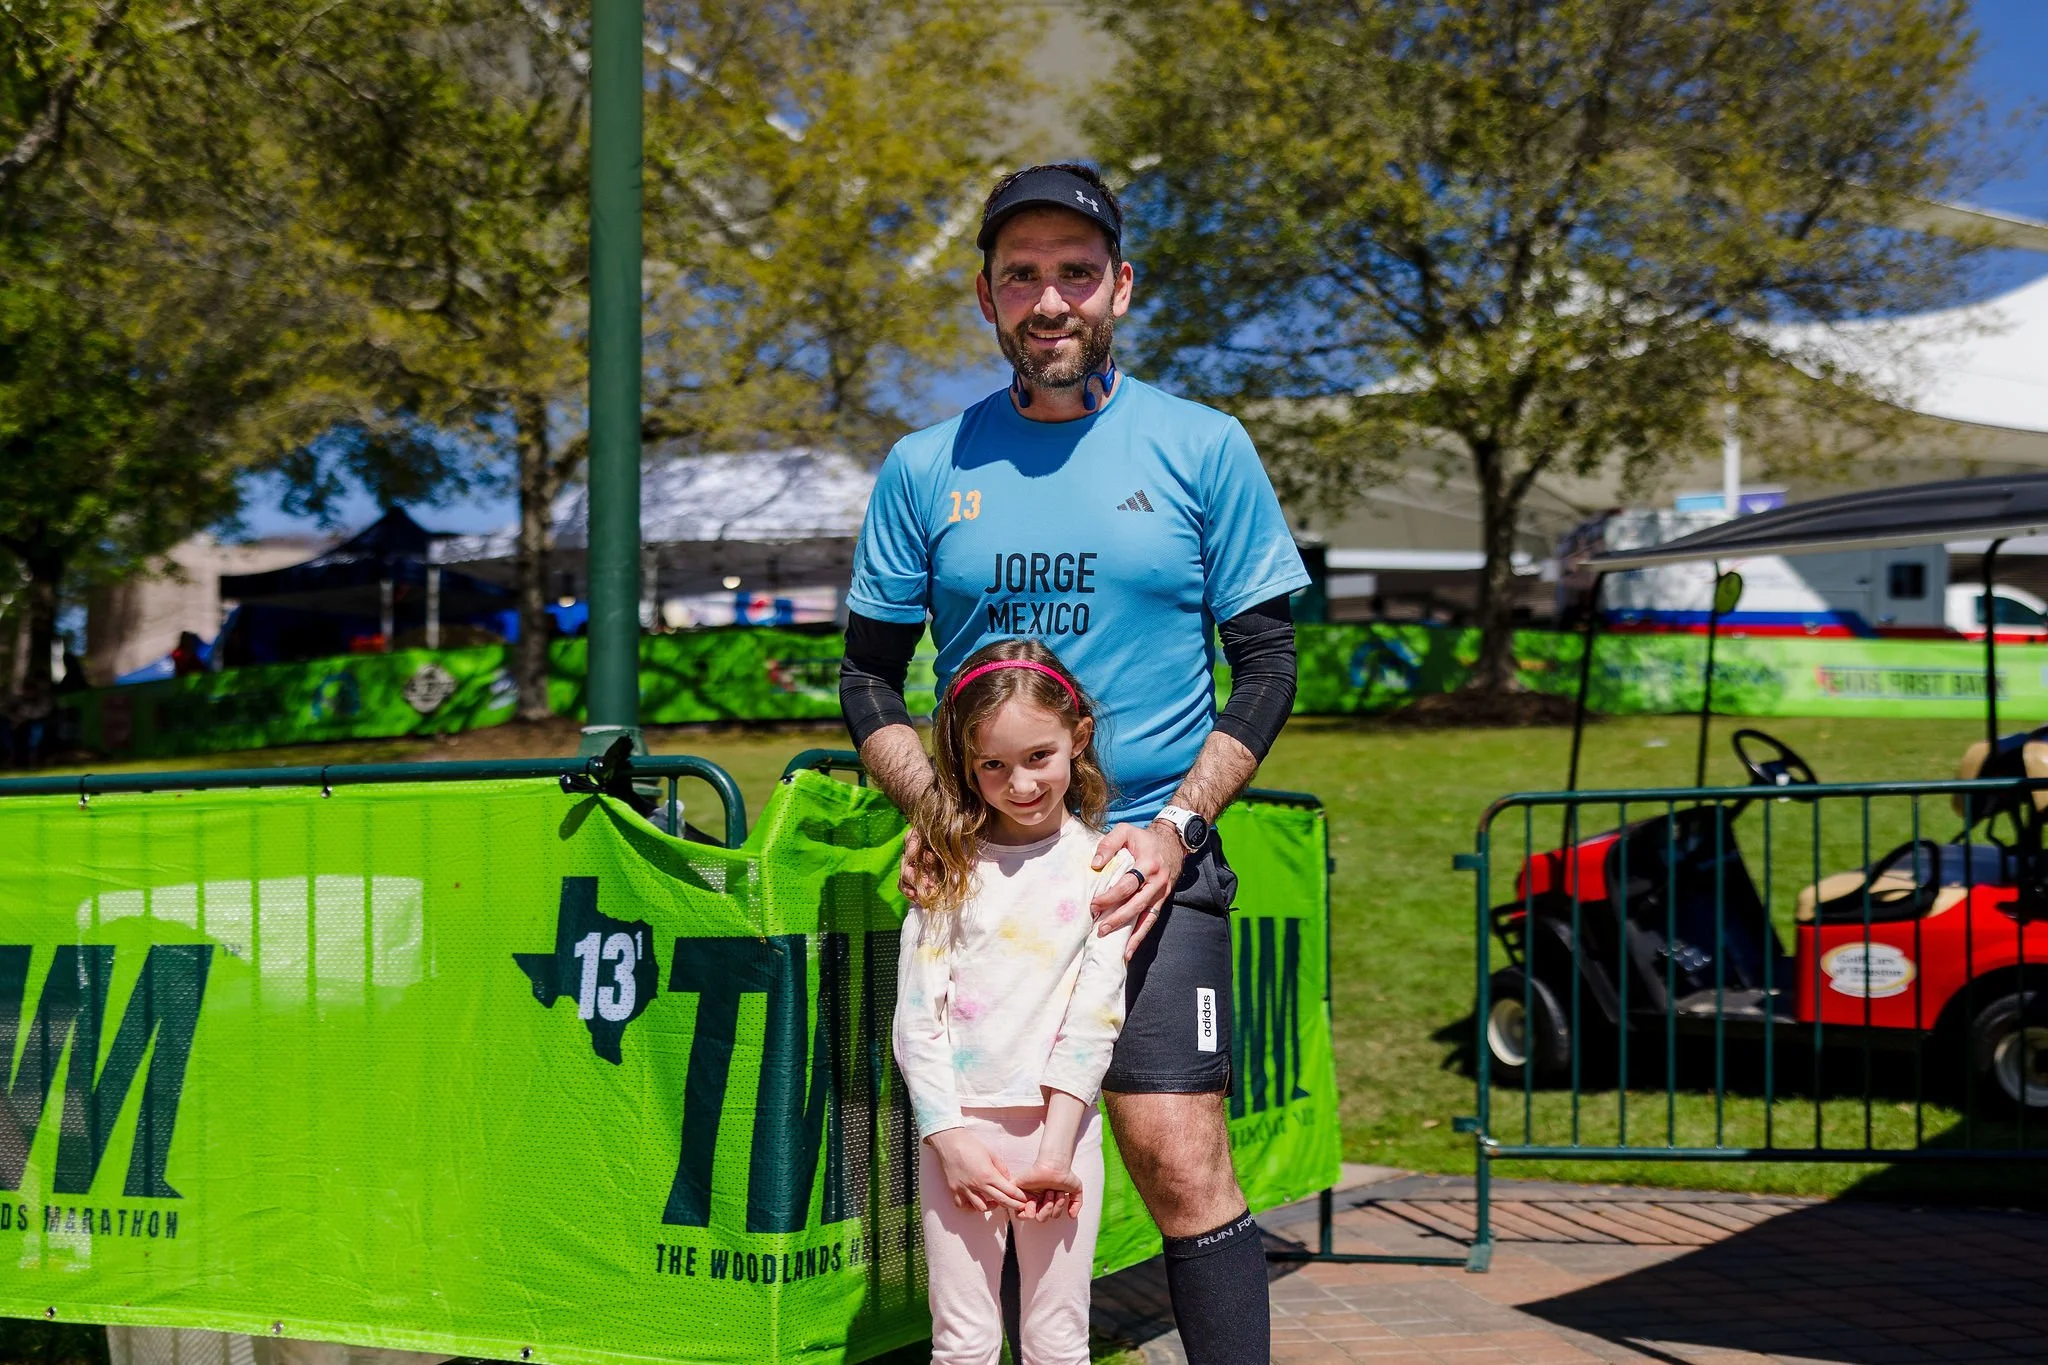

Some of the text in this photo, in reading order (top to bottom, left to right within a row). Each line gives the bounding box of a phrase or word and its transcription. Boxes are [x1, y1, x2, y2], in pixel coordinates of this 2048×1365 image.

[948, 489, 982, 523] 13
[984, 552, 1098, 595] JORGE
[987, 602, 1090, 636] MEXICO
[1202, 995, 1212, 1038] adidas
[43, 1205, 179, 1239] MARATHON
[1197, 1227, 1234, 1248] RUN
[656, 1243, 698, 1277] THE
[710, 1242, 842, 1285] WOODLANDS
